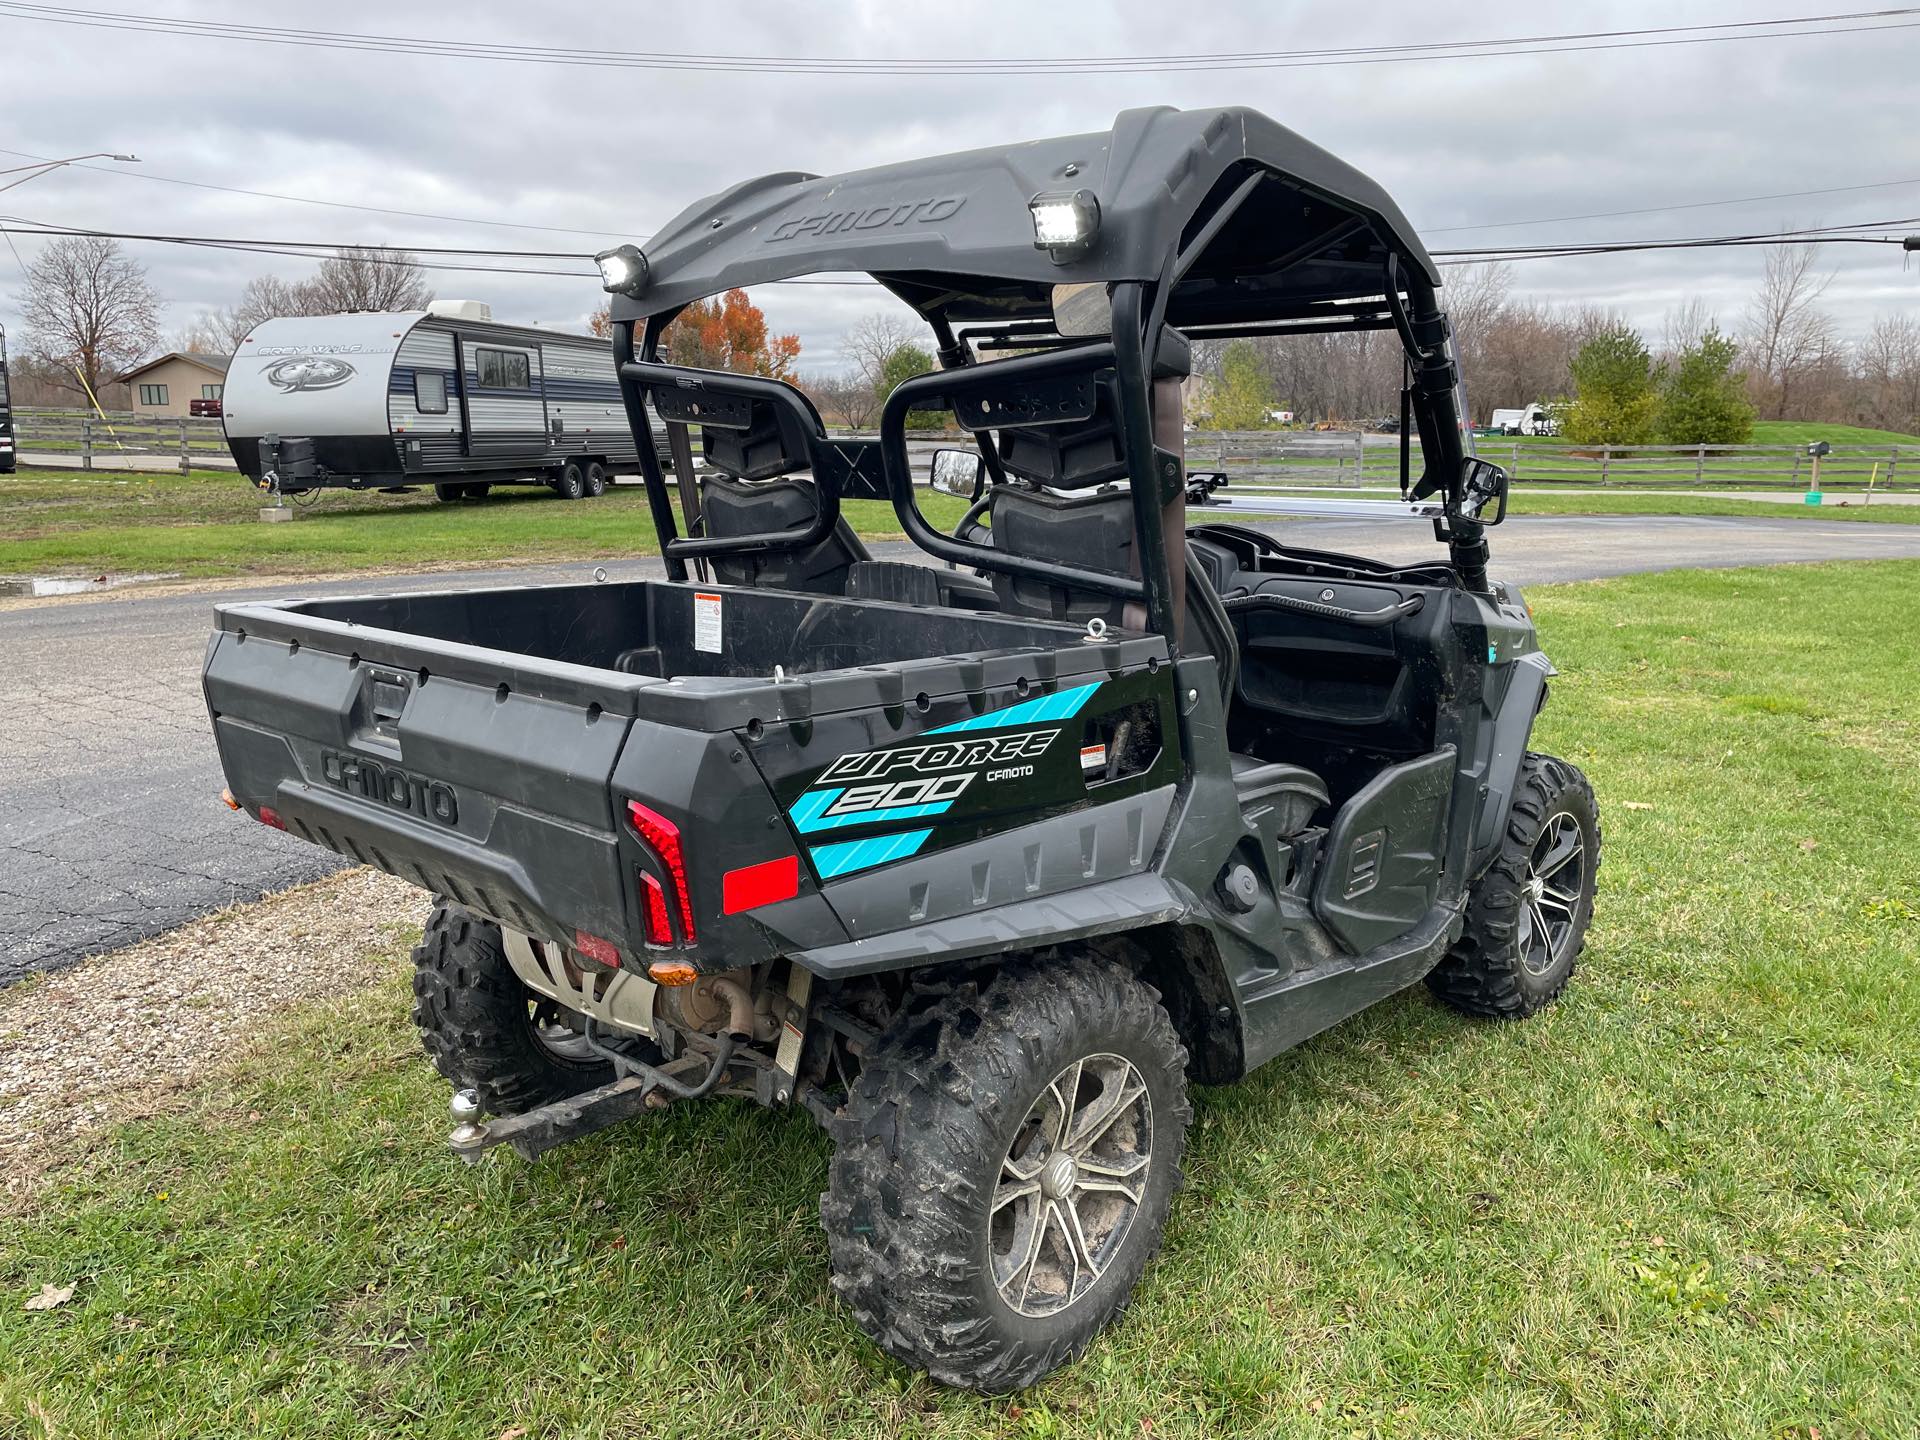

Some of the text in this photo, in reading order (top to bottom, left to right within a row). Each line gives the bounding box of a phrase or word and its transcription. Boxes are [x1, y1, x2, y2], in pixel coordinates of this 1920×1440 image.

[765, 197, 968, 244] CFMOTO
[258, 345, 307, 357] GREY
[814, 728, 1063, 785] UFORCE
[986, 765, 1034, 783] CFMOTO
[320, 750, 459, 826] CFMOTO
[825, 771, 979, 816] 800
